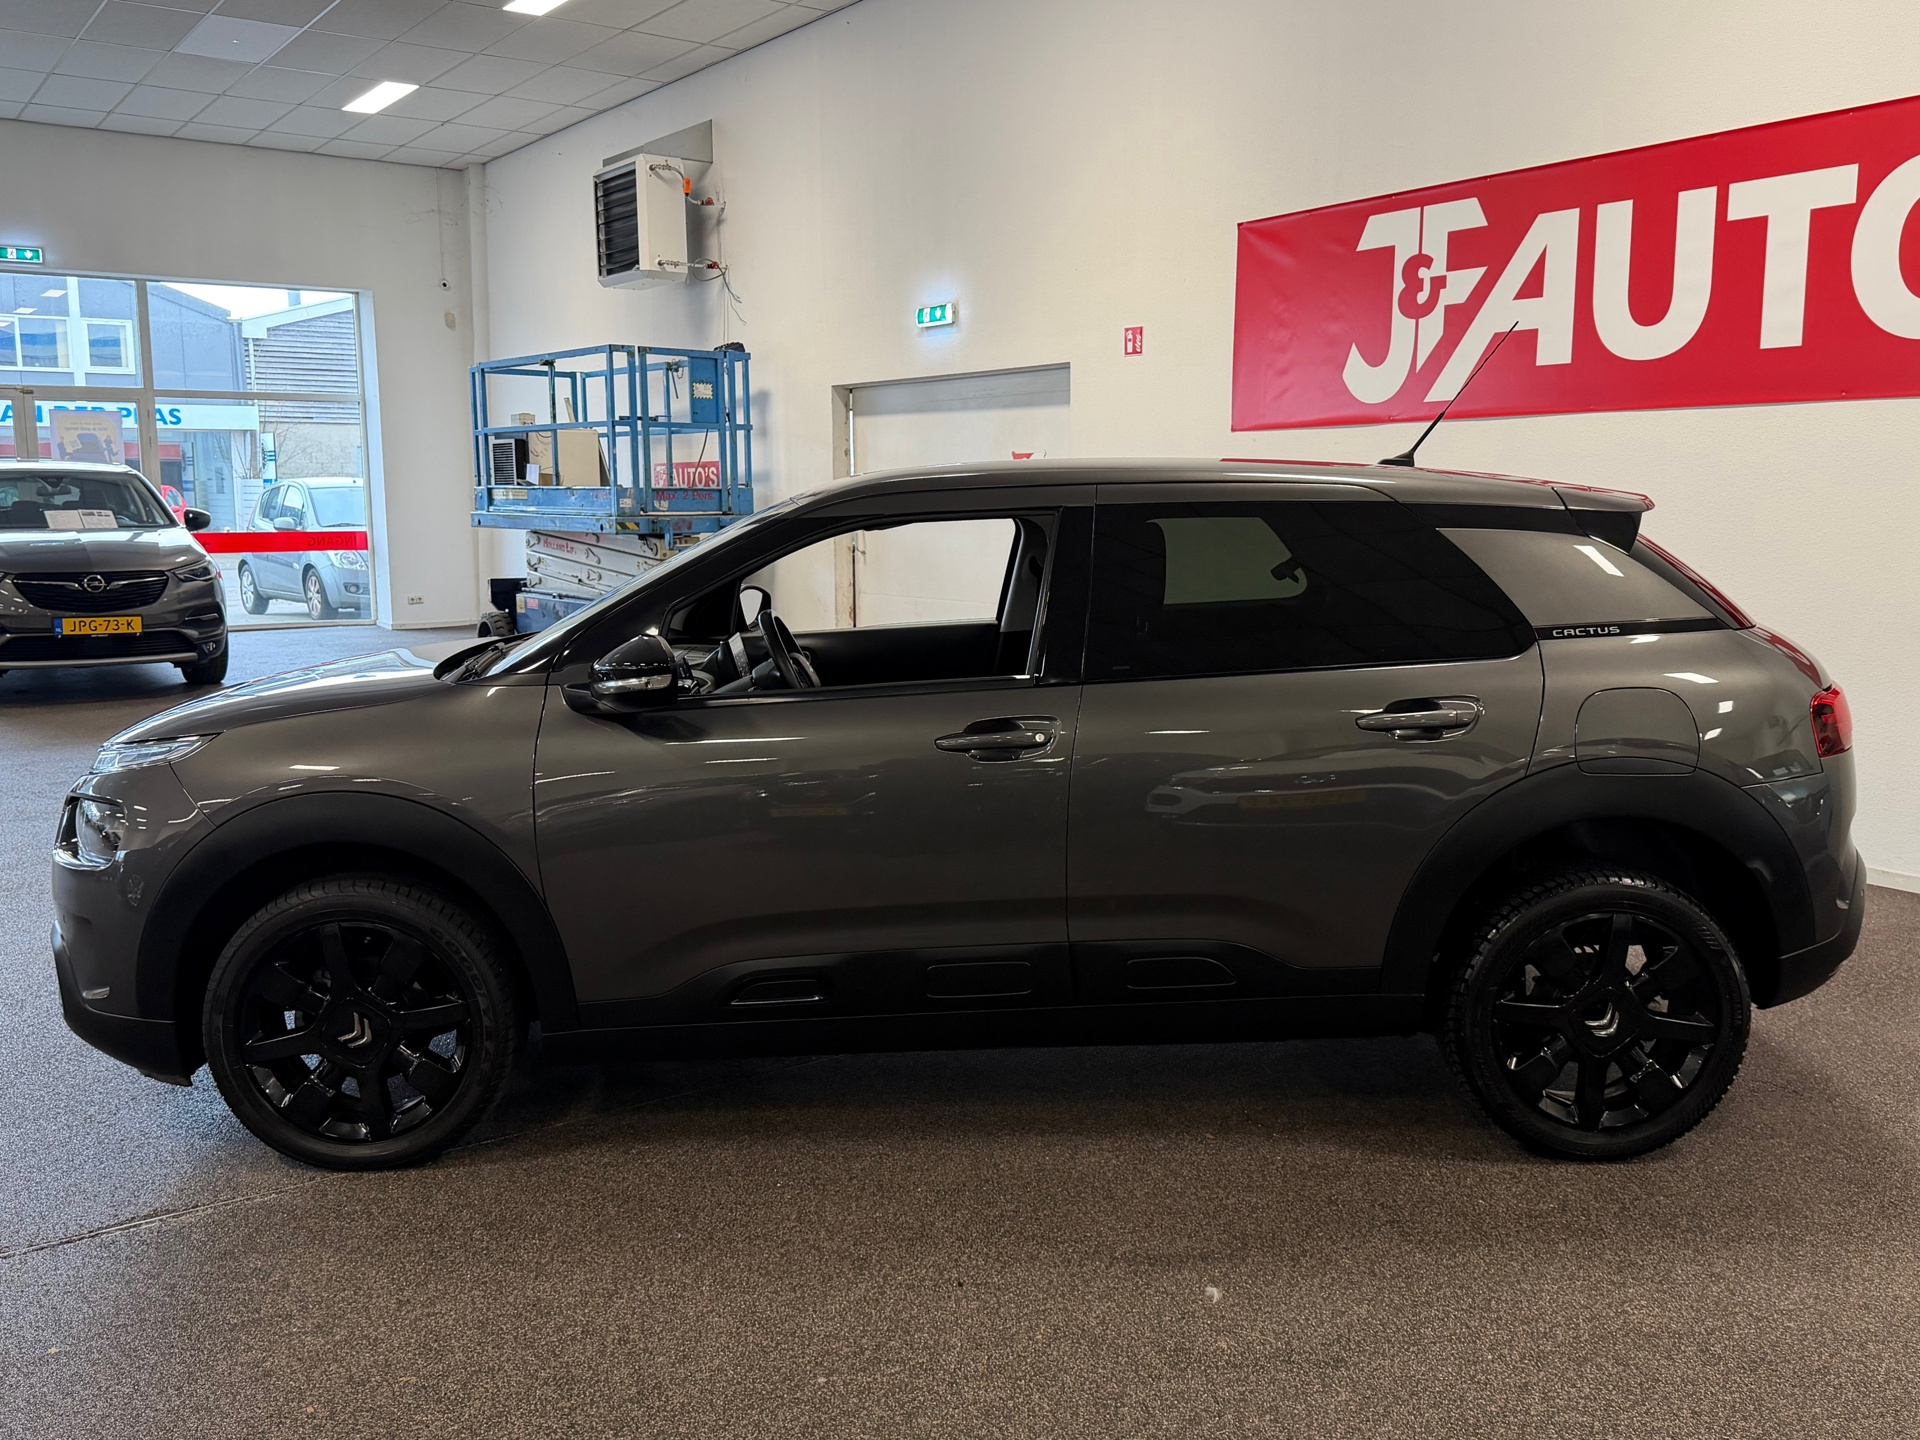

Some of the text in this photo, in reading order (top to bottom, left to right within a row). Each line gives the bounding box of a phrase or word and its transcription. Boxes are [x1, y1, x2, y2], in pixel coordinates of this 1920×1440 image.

[683, 490, 689, 500] 2
[69, 619, 135, 632] JPG-73-K
[1552, 626, 1621, 637] CACTUS
